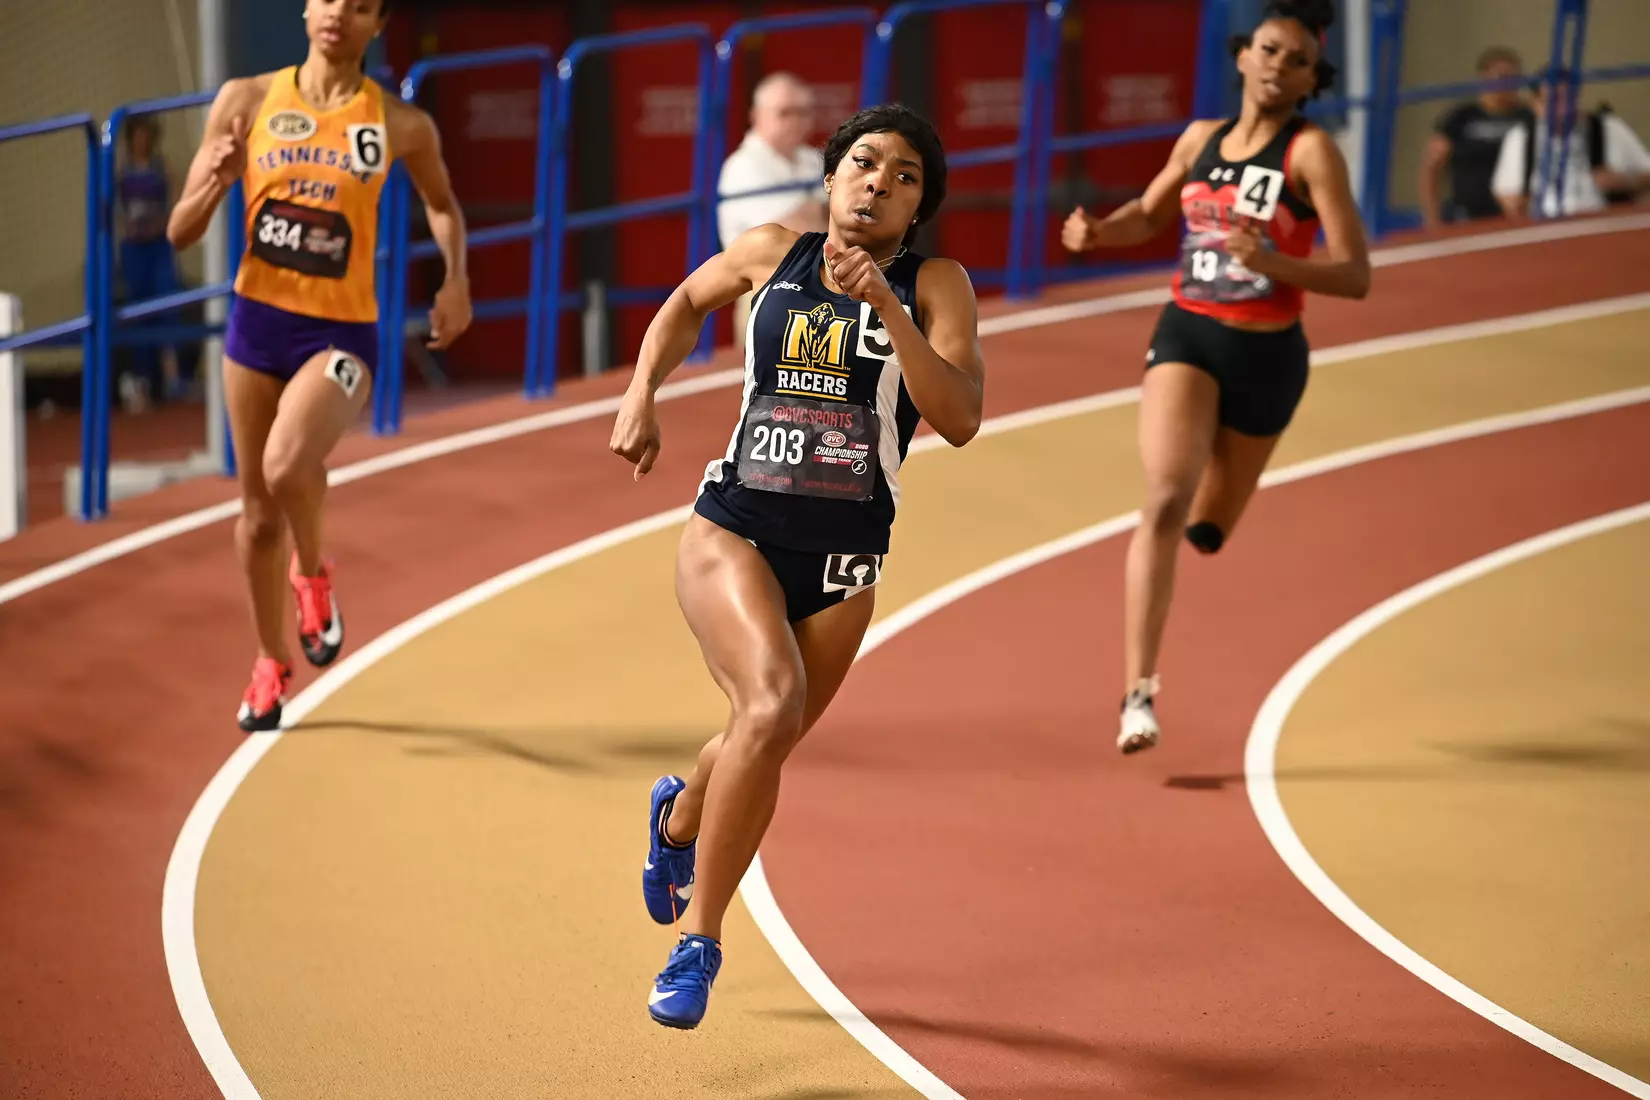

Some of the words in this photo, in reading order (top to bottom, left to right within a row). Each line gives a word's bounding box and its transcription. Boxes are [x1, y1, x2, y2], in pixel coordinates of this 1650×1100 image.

[356, 127, 382, 168] 6
[257, 146, 373, 185] TENNESS
[288, 178, 338, 201] TECH
[1244, 174, 1271, 214] 4
[258, 214, 303, 251] 334
[781, 303, 857, 370] M
[864, 303, 896, 357] 5
[334, 357, 356, 389] 6
[777, 369, 848, 396] RACERS
[772, 405, 853, 429] @OVCSPORTS
[750, 425, 805, 465] 203
[814, 445, 868, 460] CHAMPIONSHIP
[826, 435, 842, 443] OVC
[827, 554, 877, 587] 5
